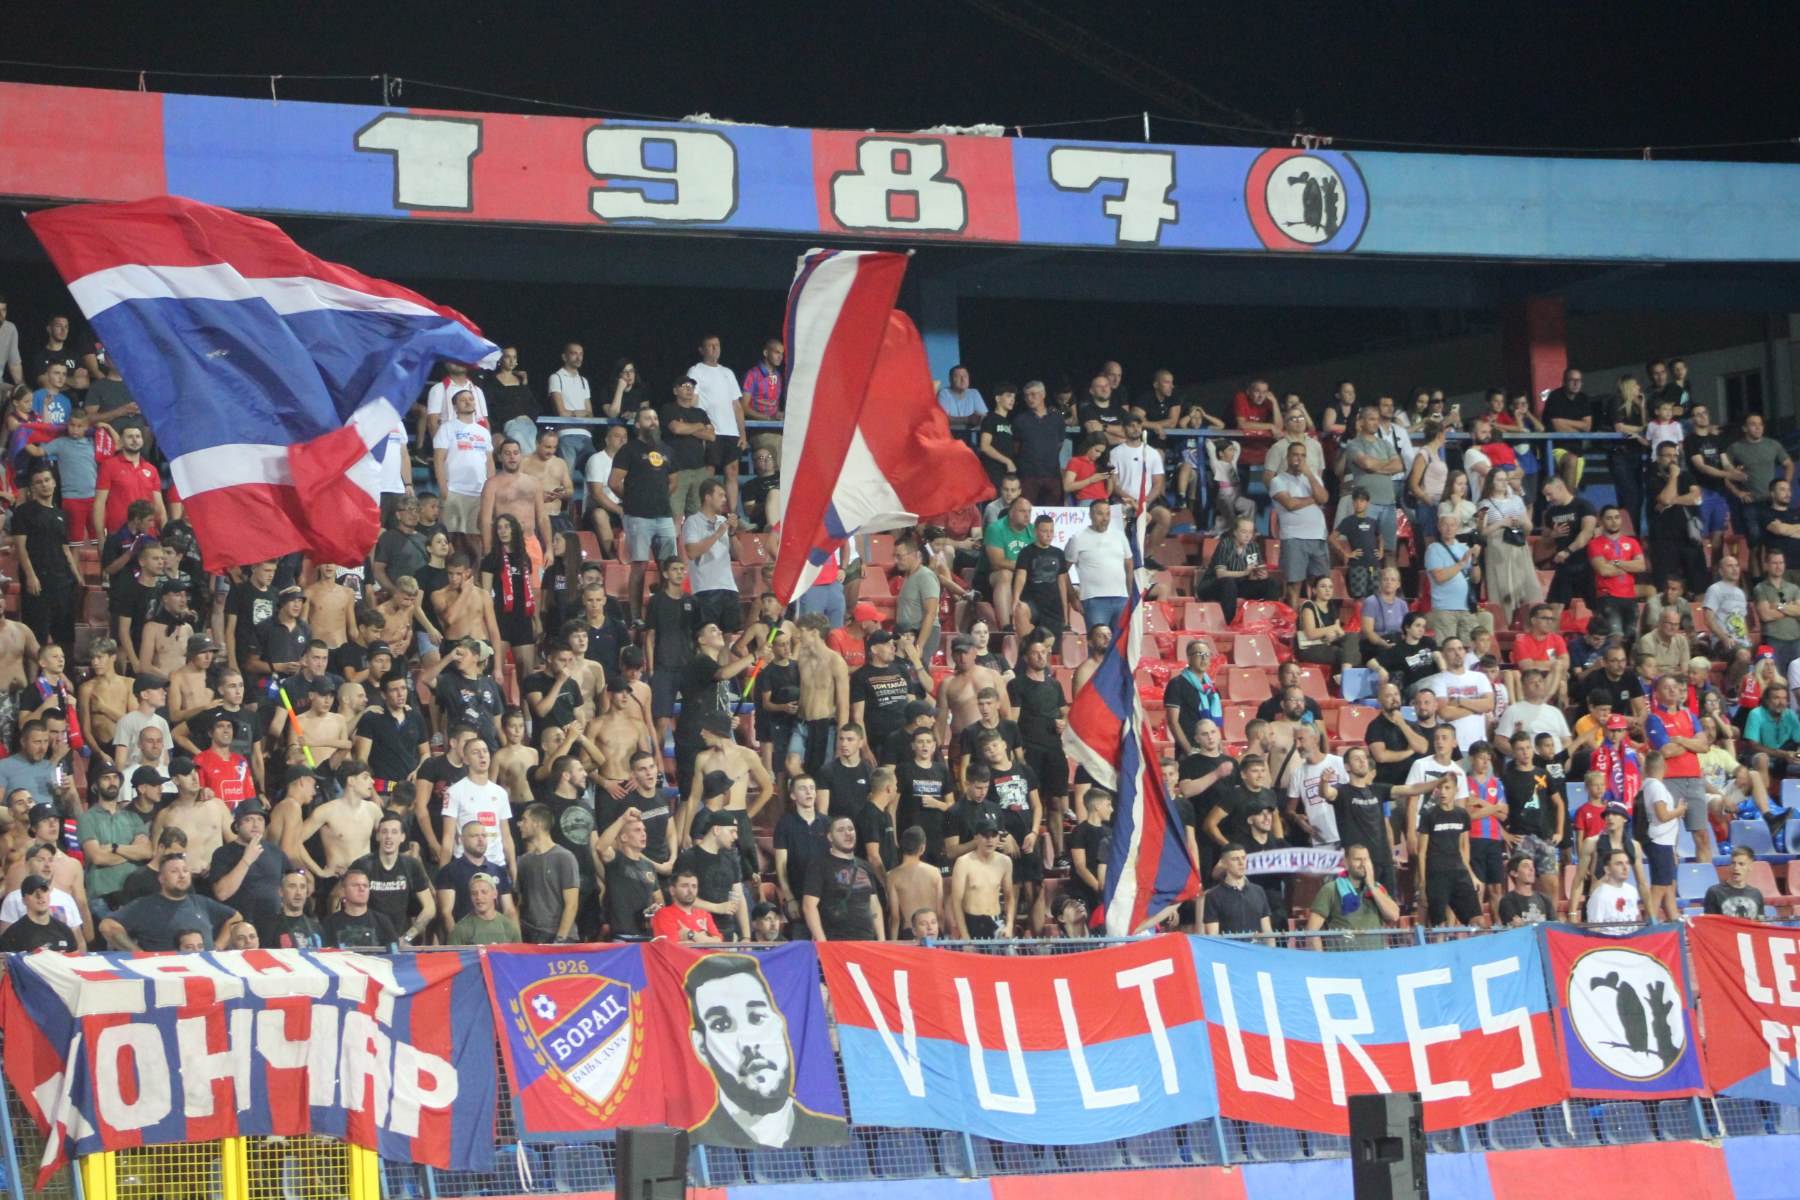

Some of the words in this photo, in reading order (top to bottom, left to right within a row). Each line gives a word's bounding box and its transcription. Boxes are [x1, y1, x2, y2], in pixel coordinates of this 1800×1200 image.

[354, 114, 1179, 245] 1987
[547, 959, 590, 976] 1926
[1737, 932, 1800, 1008] LE
[550, 994, 627, 1061] БОРАЦ
[846, 955, 1542, 1115] VULTURES
[572, 1055, 603, 1083] БАЊА
